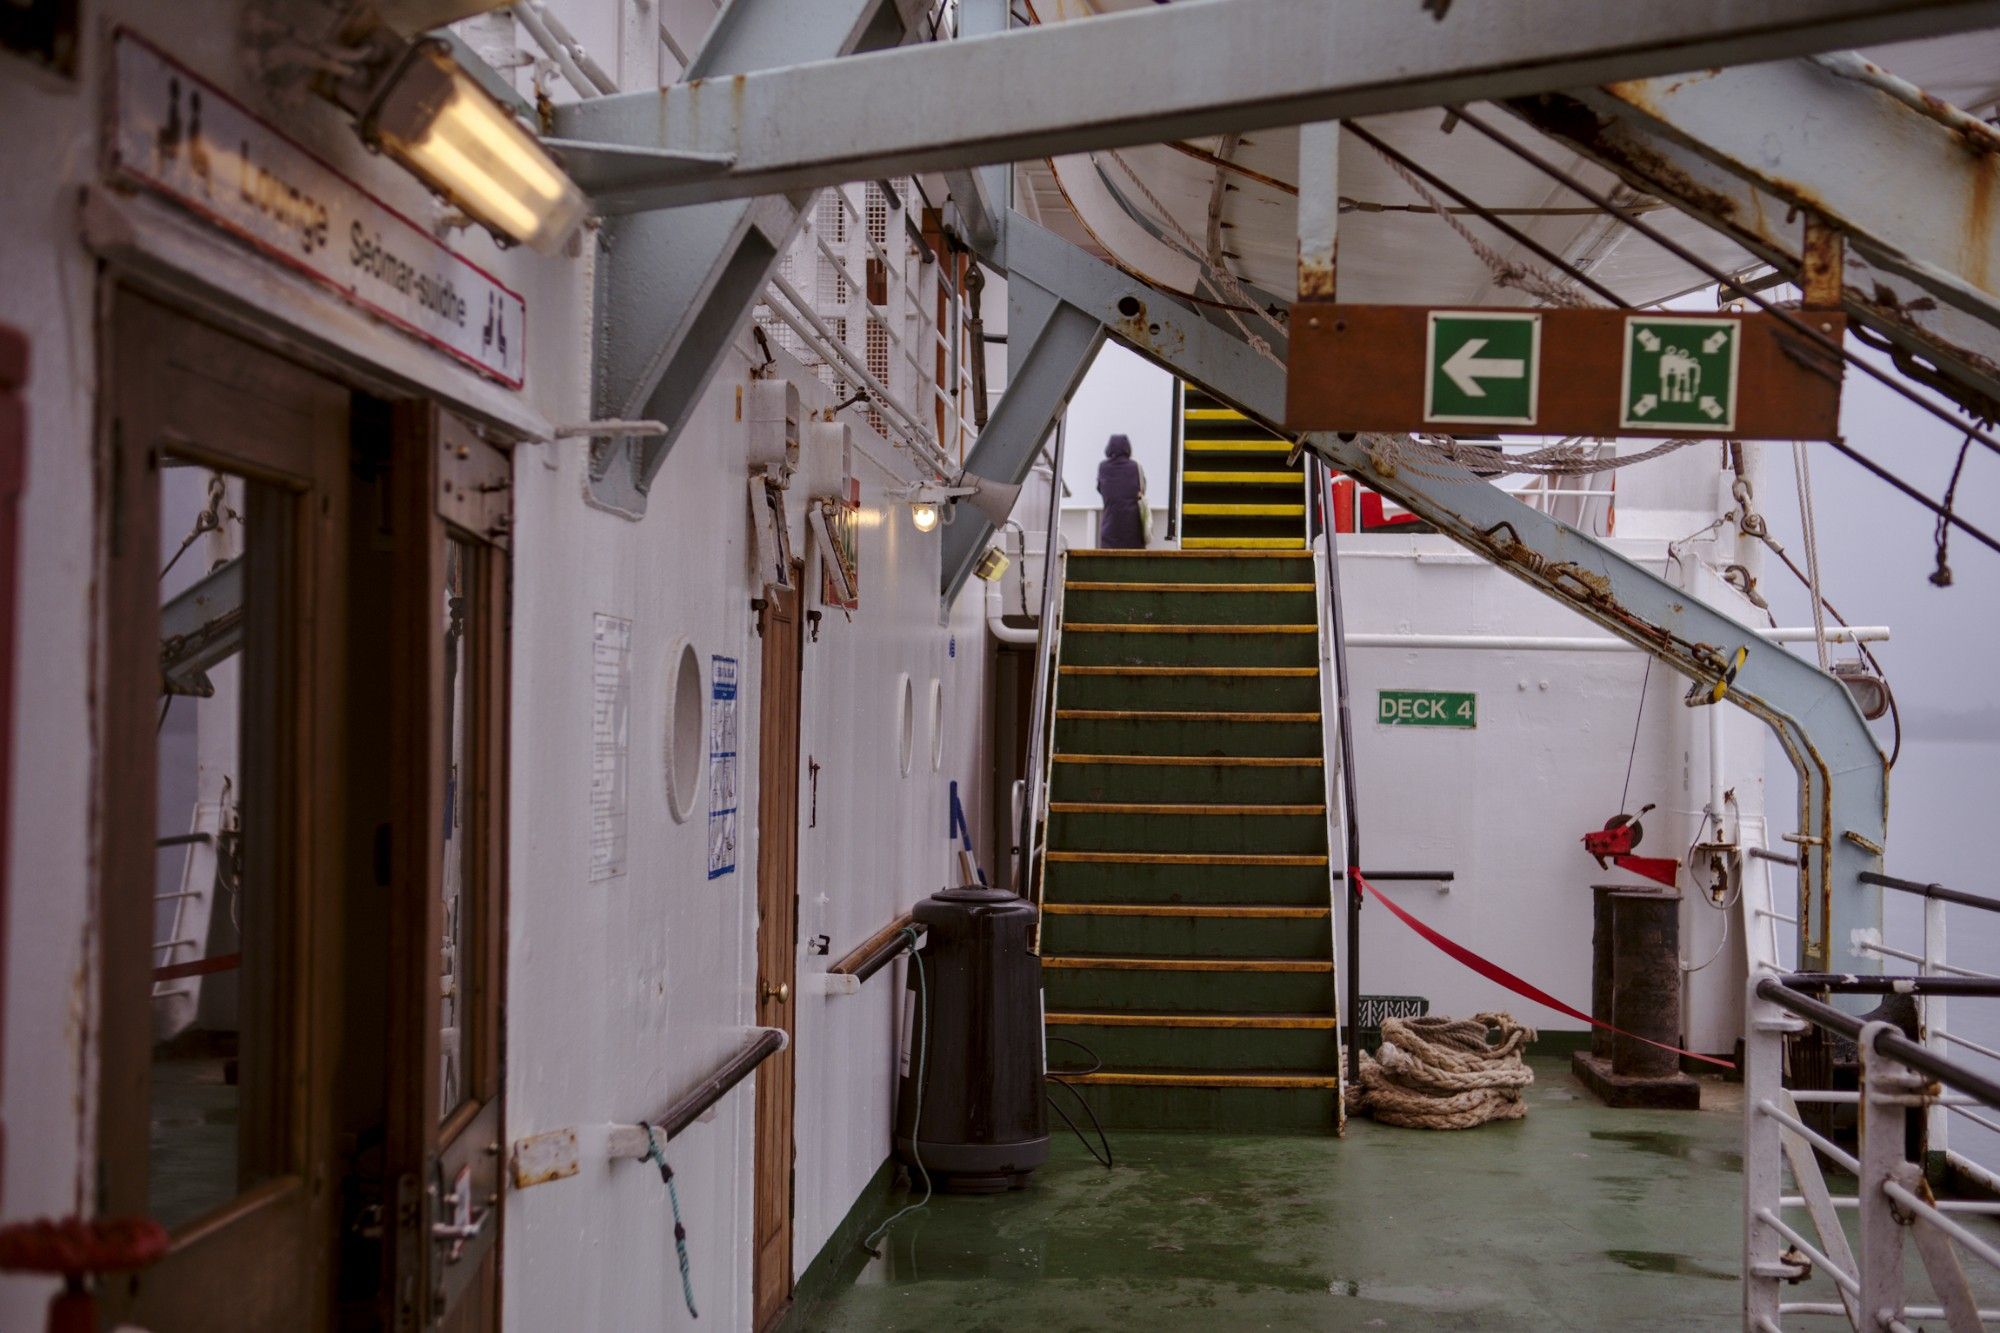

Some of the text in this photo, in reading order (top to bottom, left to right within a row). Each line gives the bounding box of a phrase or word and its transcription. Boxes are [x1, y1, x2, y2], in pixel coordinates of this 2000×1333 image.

[241, 139, 328, 254] Lounge
[1381, 698, 1472, 720] DECK 4
